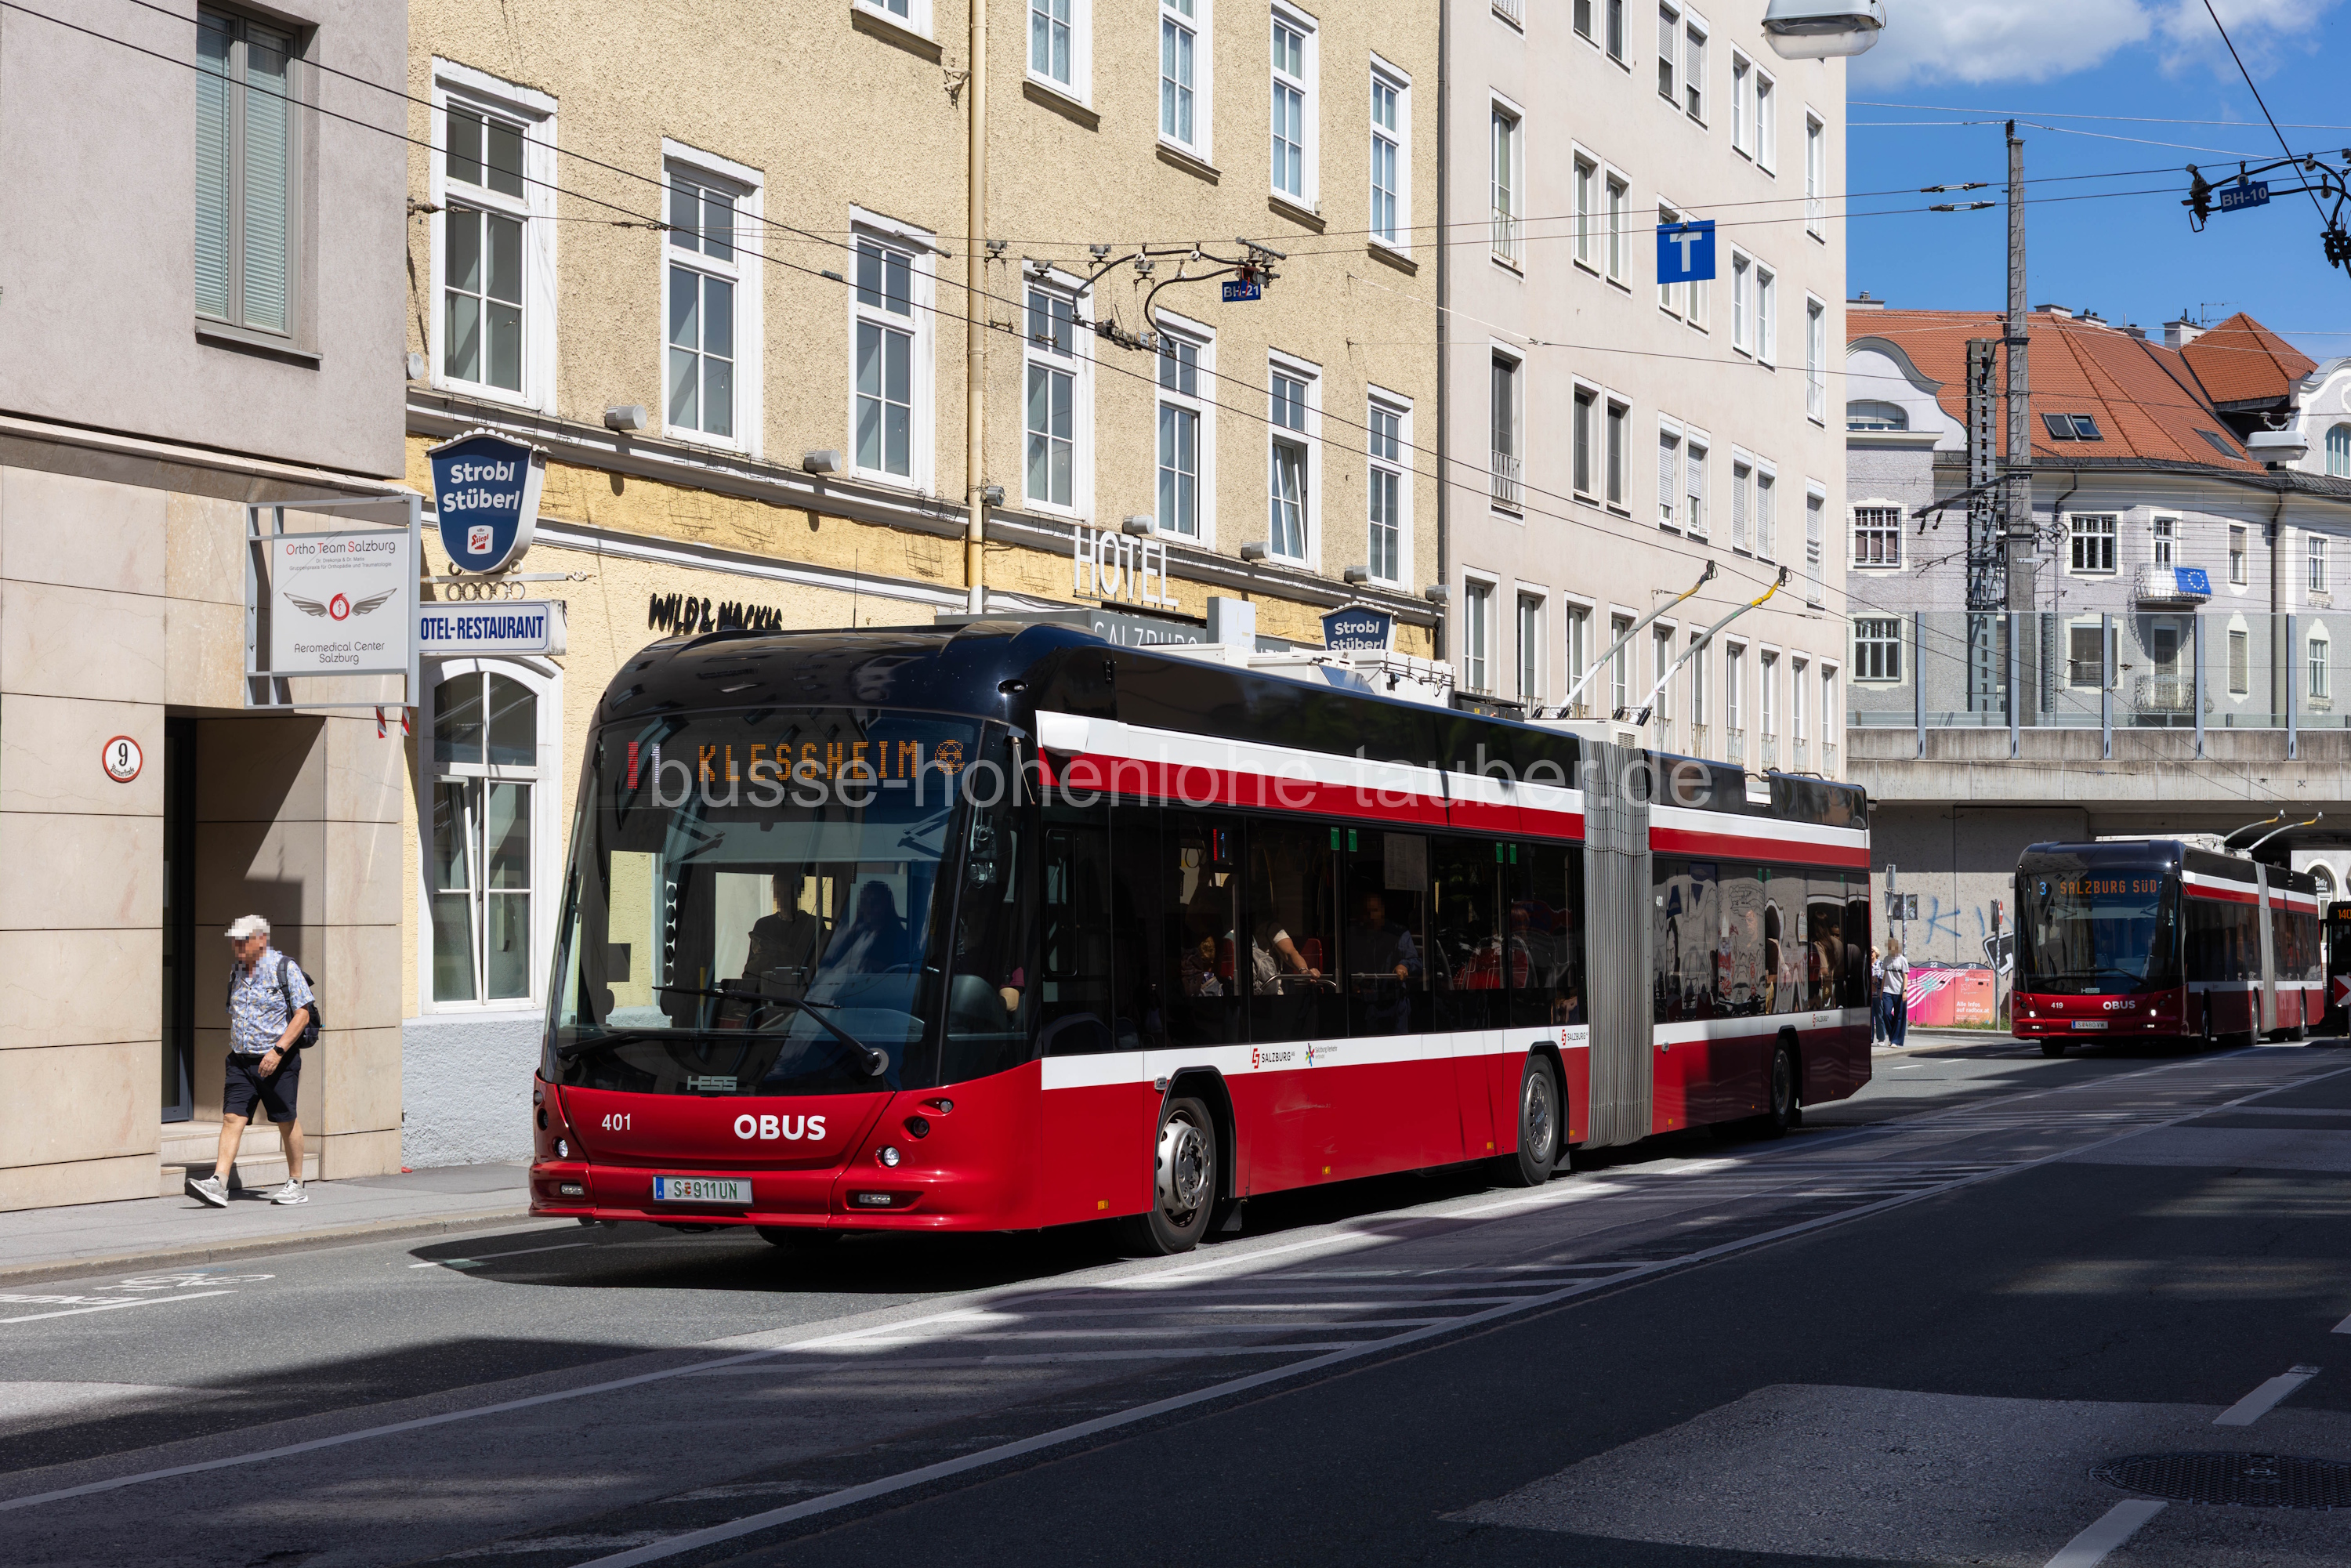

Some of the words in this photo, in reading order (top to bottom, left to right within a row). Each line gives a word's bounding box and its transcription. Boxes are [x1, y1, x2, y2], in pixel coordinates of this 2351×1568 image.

[2221, 187, 2267, 207] BH-10
[1670, 231, 1702, 272] T
[1223, 285, 1259, 298] BH-21
[450, 461, 515, 484] Strobl
[443, 488, 520, 512] Stüberl
[286, 543, 315, 555] Ortho
[317, 542, 346, 554] Team
[348, 540, 396, 554] Salzburg
[471, 533, 489, 547] Stiegl
[1074, 525, 1179, 607] HOTEL
[648, 592, 699, 636] WILD
[419, 616, 544, 640] OTEL-RESTAURANT
[1335, 620, 1380, 635] Strobl
[294, 642, 351, 653] Aeromedical
[354, 641, 385, 651] Center
[1330, 637, 1384, 650] Stüberl
[319, 653, 359, 665] Salzburg
[118, 742, 128, 767] 9
[651, 746, 659, 784] 1
[699, 740, 918, 782] KLESSHEIM
[2039, 882, 2047, 896] 3
[2060, 880, 2126, 894] SALZBURG
[2133, 879, 2157, 893] SÜD
[2338, 909, 2351, 919] 140
[2103, 1000, 2135, 1010] OBUS
[1262, 1052, 1291, 1063] SALZBURG
[687, 1076, 737, 1091] HESS
[601, 1113, 630, 1131] 401
[734, 1114, 826, 1141] OBUS
[674, 1180, 682, 1198] S
